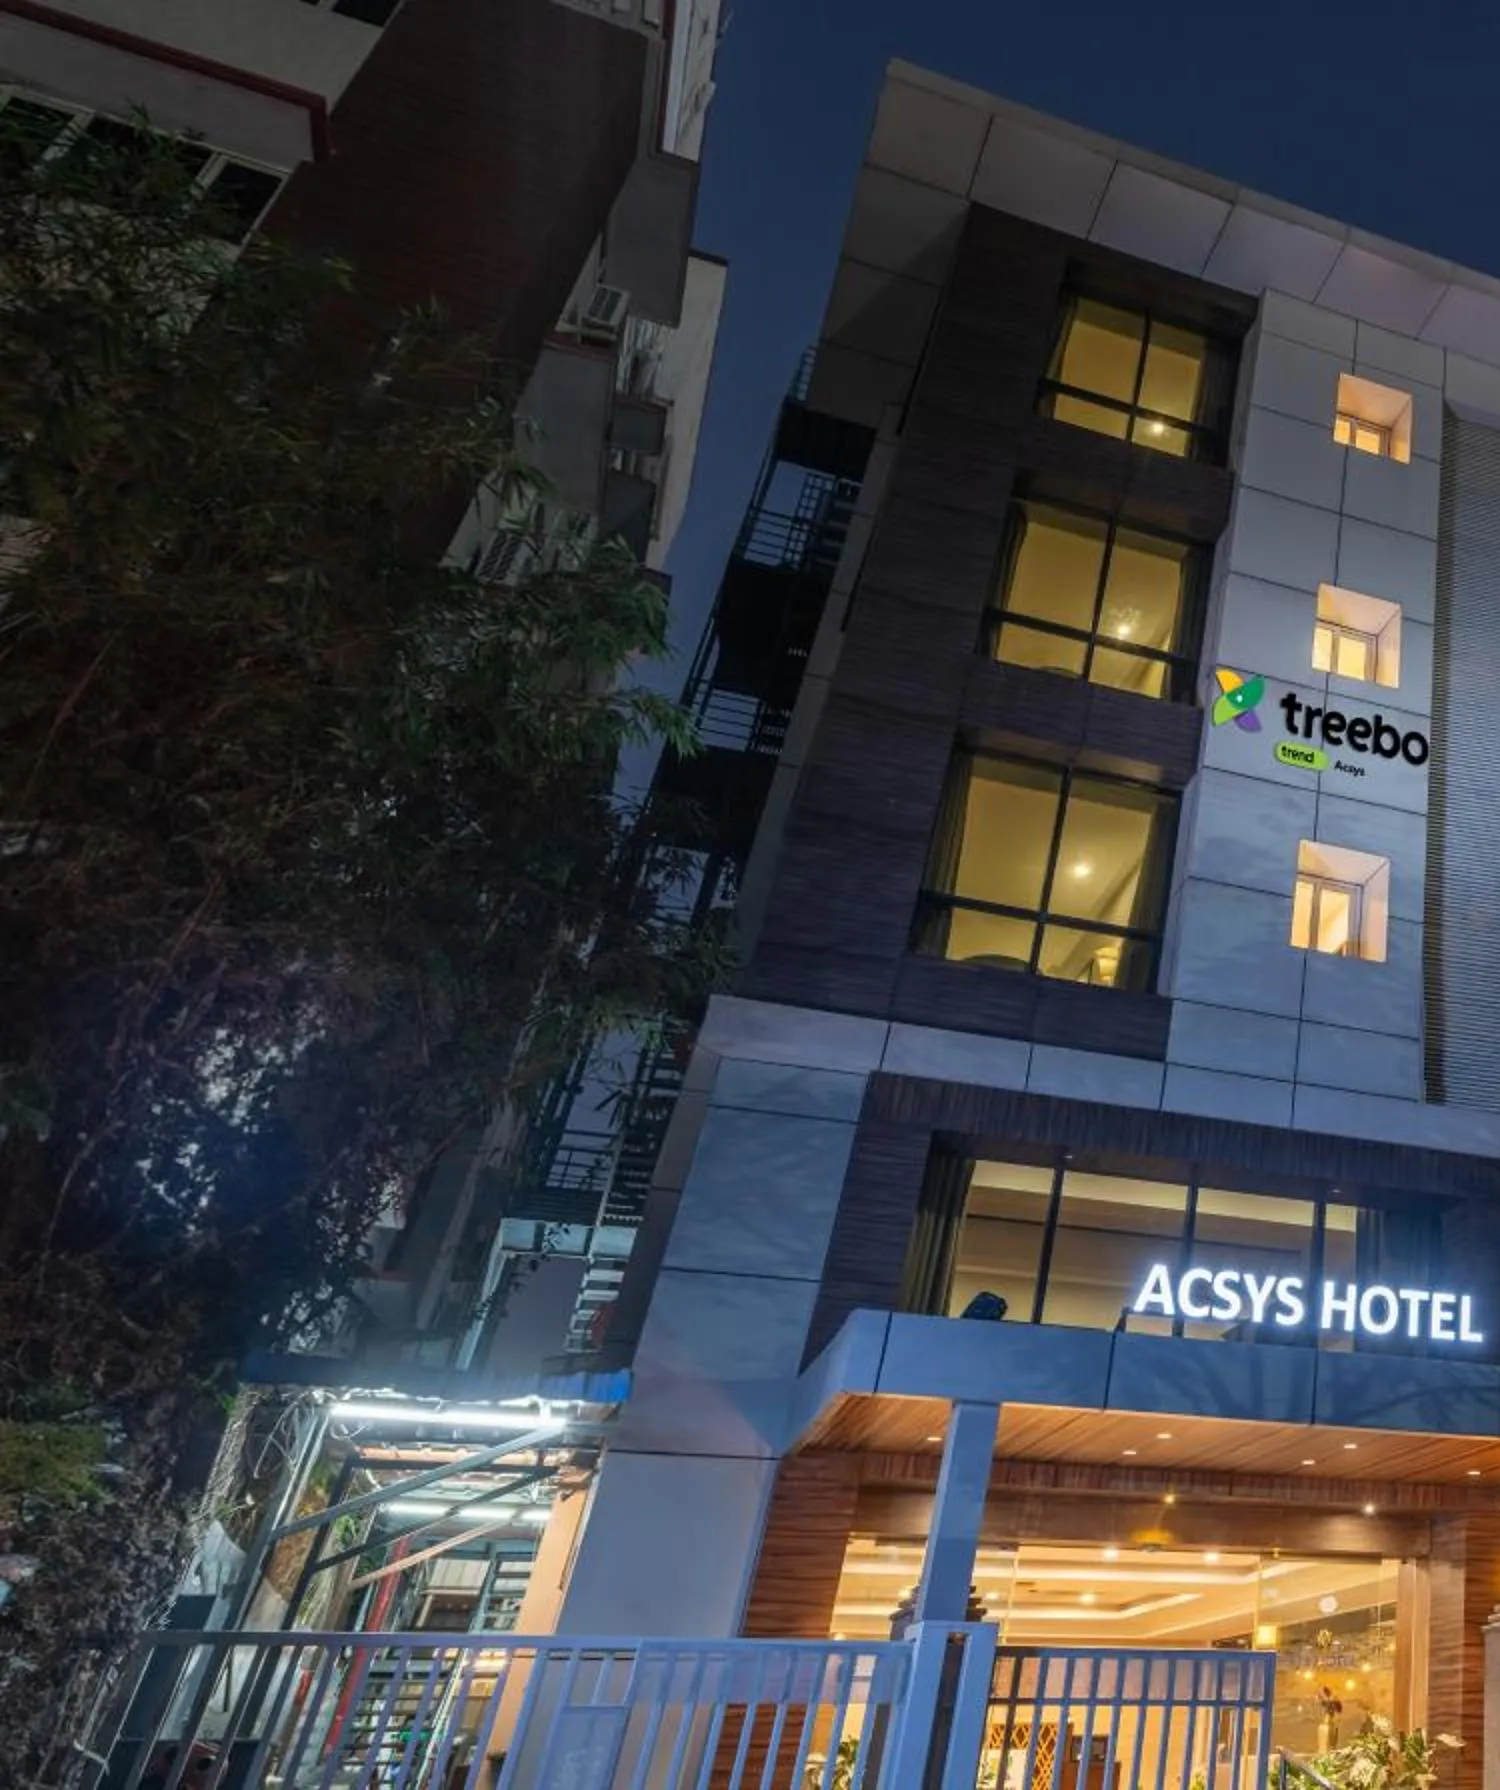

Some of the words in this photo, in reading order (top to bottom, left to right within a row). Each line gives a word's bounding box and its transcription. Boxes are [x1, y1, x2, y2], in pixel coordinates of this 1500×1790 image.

[1280, 692, 1429, 765] treebo
[1132, 1263, 1305, 1326] ACSYS
[1320, 1279, 1484, 1343] HOTEL
